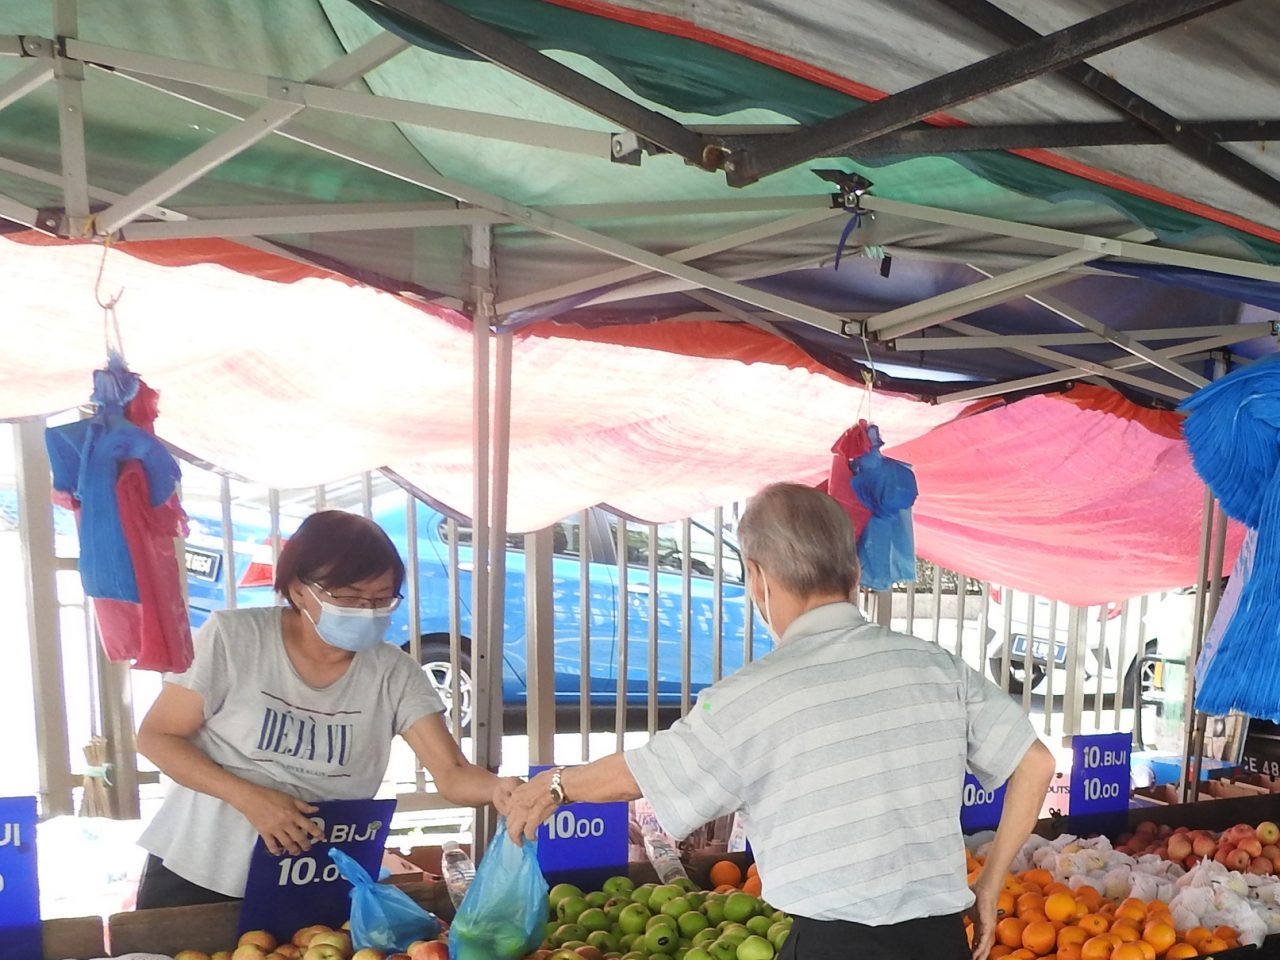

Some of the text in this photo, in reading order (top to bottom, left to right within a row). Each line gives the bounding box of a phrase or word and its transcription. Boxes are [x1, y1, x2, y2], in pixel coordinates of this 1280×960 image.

[327, 724, 353, 767] VU
[1083, 745, 1127, 769] 10.BIJI
[1083, 778, 1120, 801] 10.00
[543, 810, 605, 840] 10.00
[278, 856, 350, 886] 10.0
